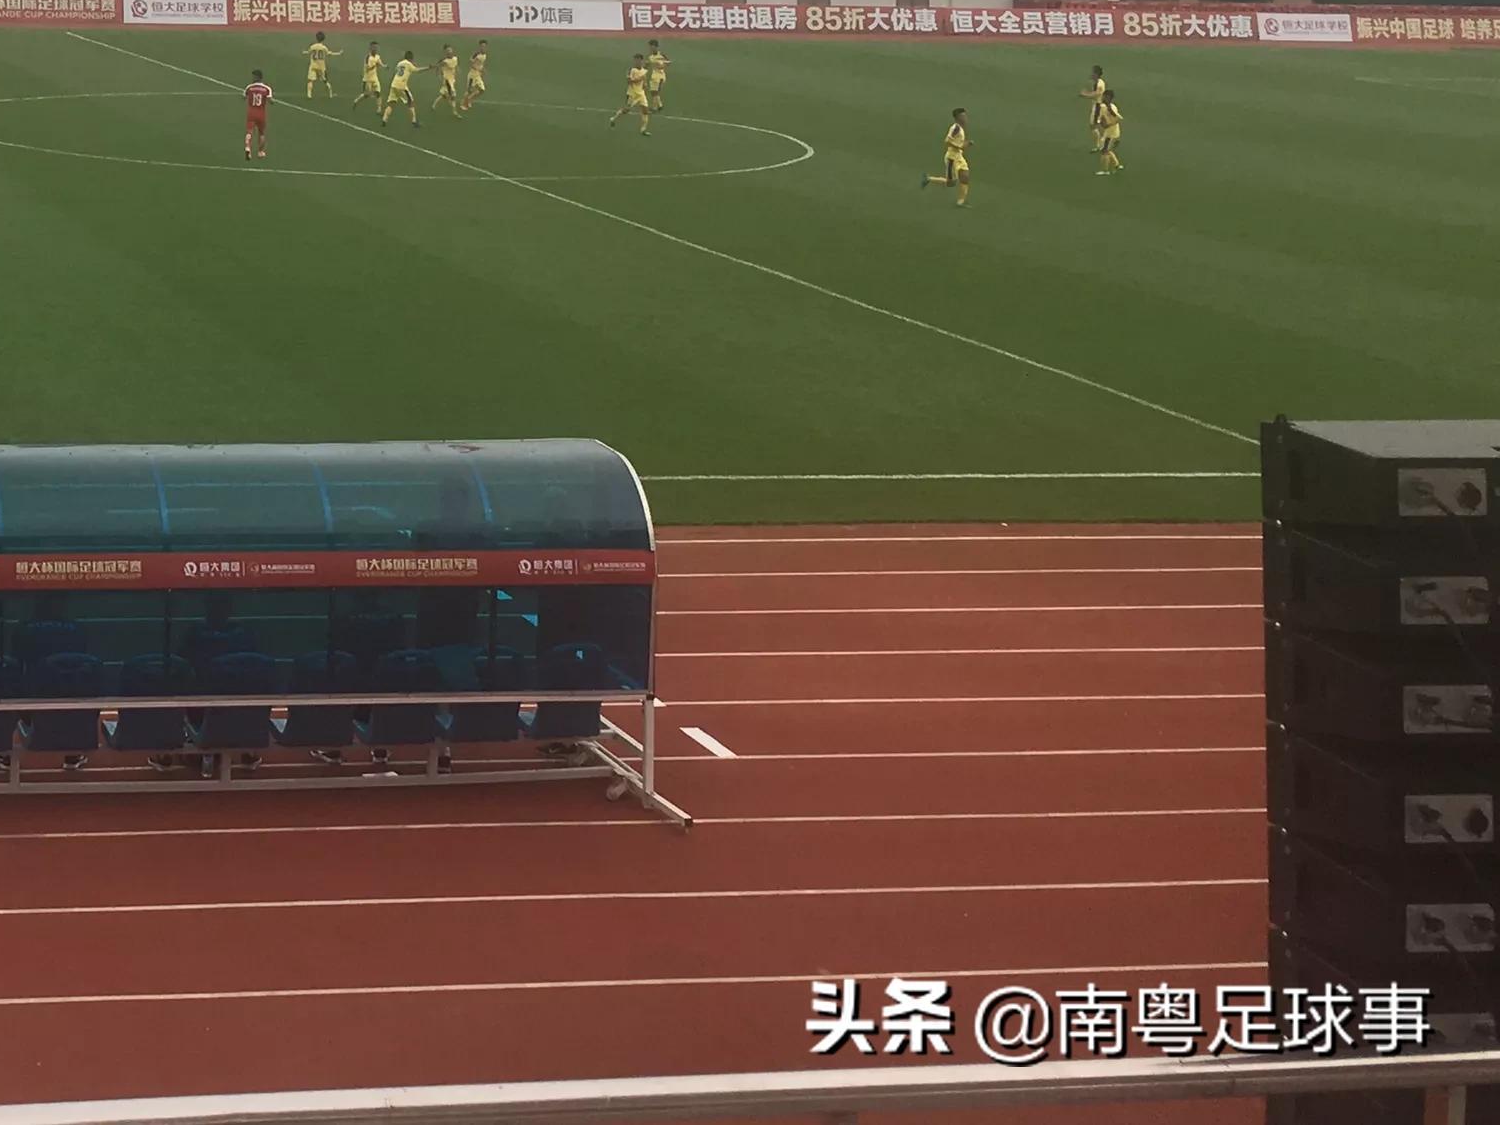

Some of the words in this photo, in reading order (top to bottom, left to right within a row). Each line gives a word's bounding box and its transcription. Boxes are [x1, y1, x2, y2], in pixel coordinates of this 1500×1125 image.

[24, 10, 44, 18] CUP
[151, 2, 223, 13] 恒大足球学校
[348, 0, 455, 25] 培养足球明星
[629, 4, 797, 30] 恒大无理由退房
[806, 7, 938, 33] 85折大优惠
[950, 9, 1114, 36] 恒大全员营销月
[1123, 11, 1253, 38] 85折大优惠
[1357, 17, 1455, 39] 振兴中国足球
